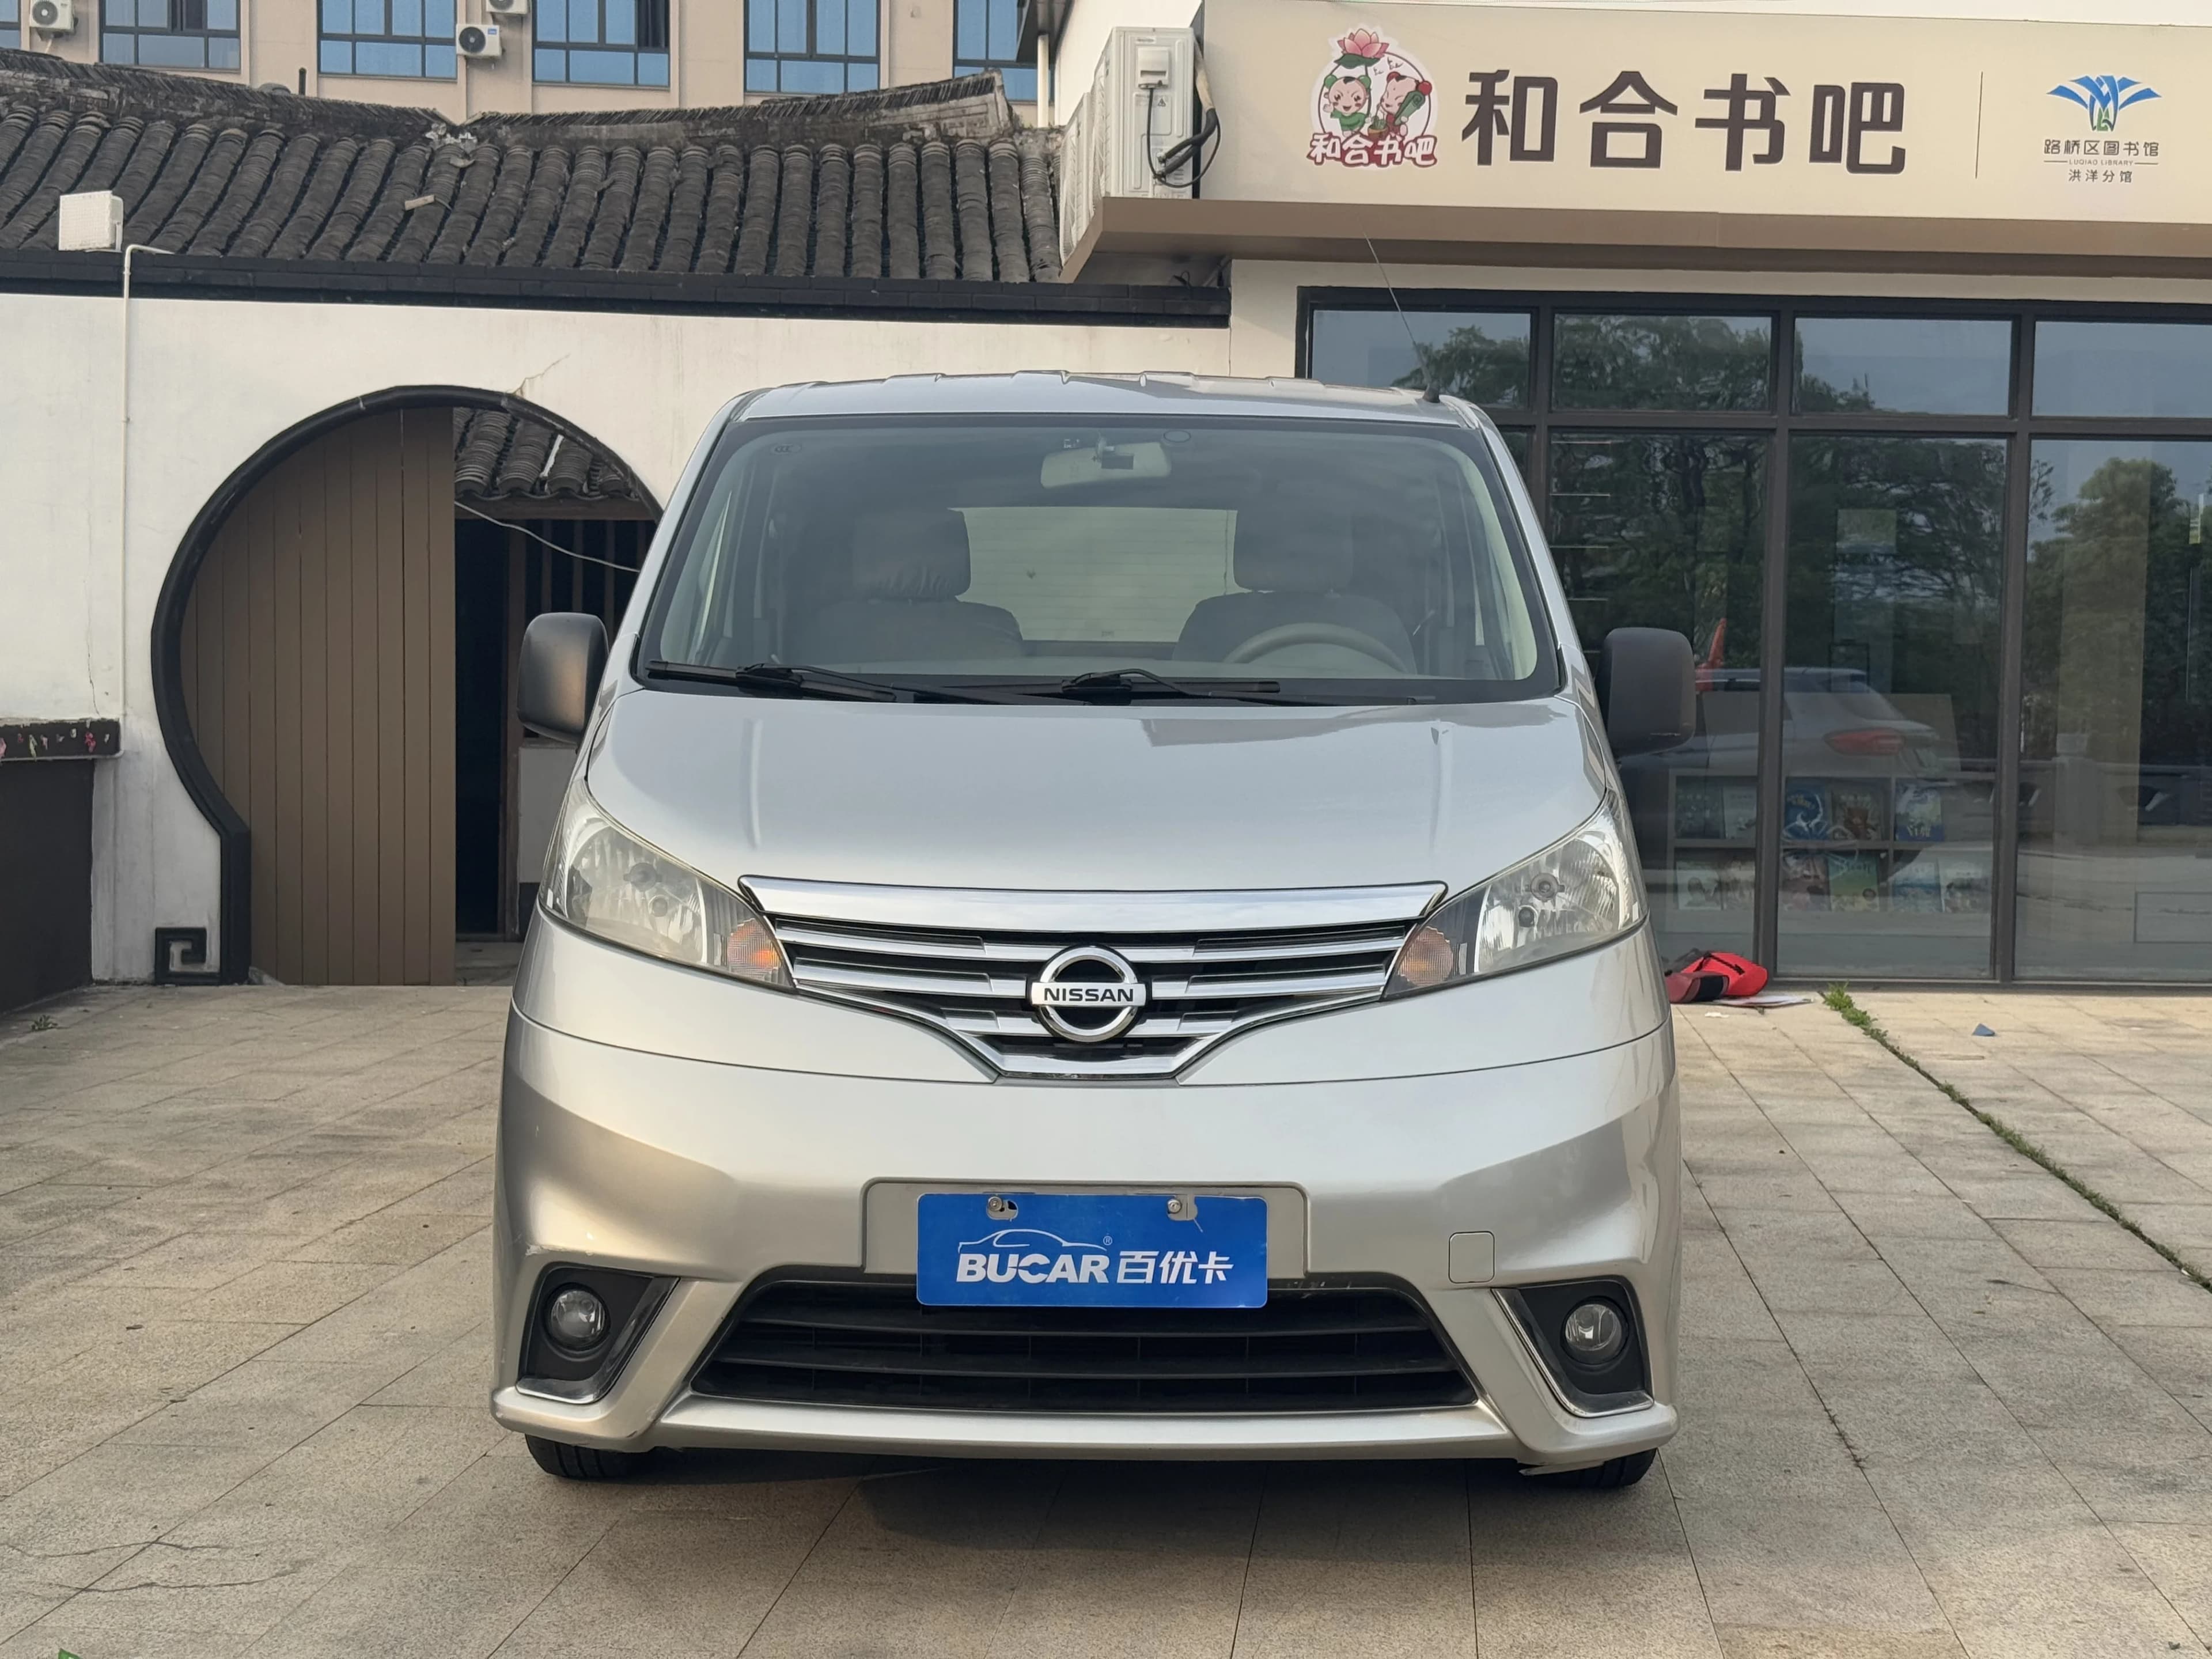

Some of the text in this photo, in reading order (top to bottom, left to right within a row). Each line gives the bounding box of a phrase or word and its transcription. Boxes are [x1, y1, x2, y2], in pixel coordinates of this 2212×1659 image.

[1461, 69, 1906, 175] 和合书吧
[1309, 133, 1435, 166] 和合书吧
[2069, 169, 2133, 183] 洪洋分馆
[1044, 987, 1134, 1002] NISSAN
[956, 1250, 1234, 1285] BUCAR 百优卡
